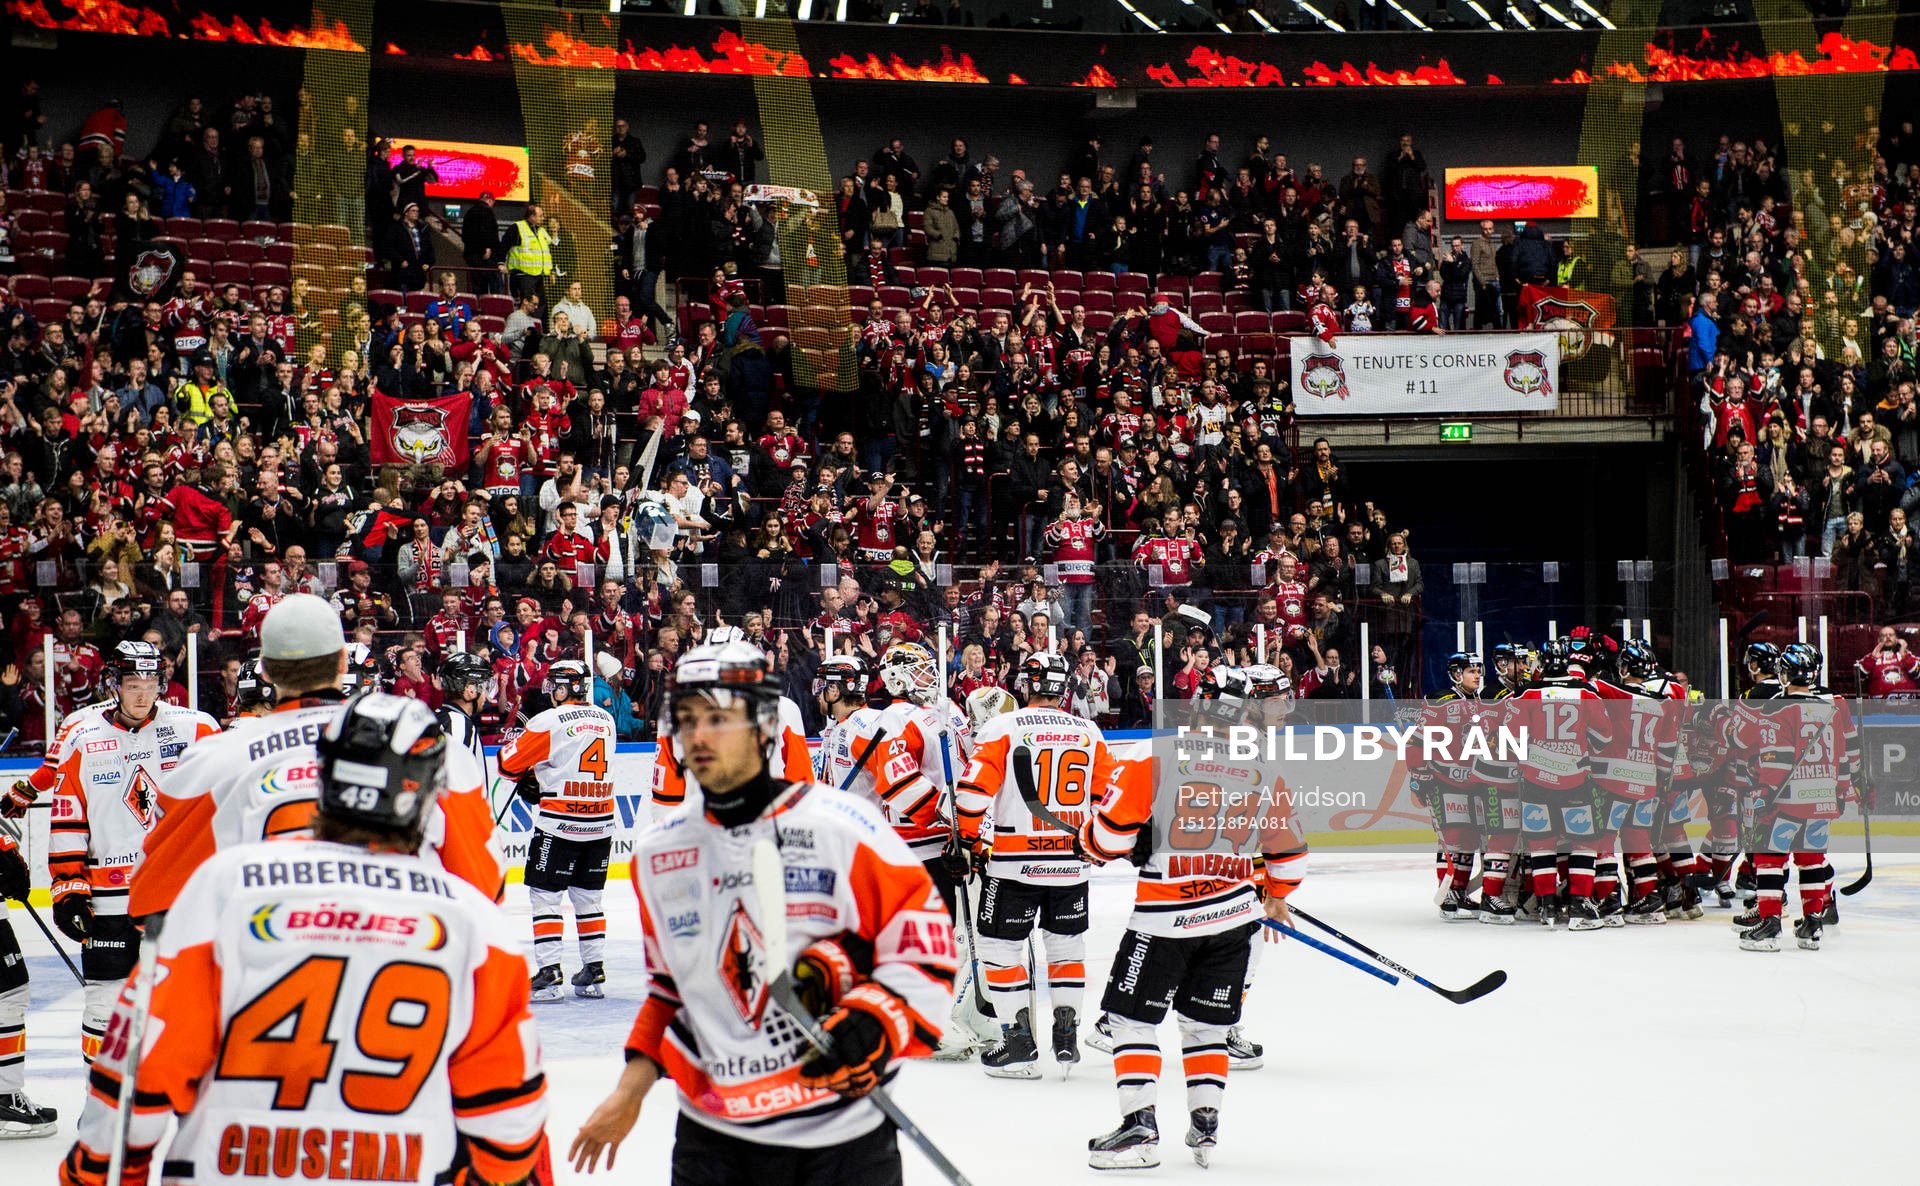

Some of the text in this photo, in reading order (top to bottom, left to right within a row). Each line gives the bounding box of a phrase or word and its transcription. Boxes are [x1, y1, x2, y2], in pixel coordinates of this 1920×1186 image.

[1432, 353, 1497, 368] CORNER
[1406, 380, 1438, 395] #11
[1049, 682, 1061, 692] 16
[1542, 703, 1579, 740] 12
[86, 741, 117, 753] SAVE
[157, 731, 176, 739] KRONA
[1035, 731, 1081, 743] BÖRJES
[1760, 728, 1777, 745] 39
[1800, 723, 1835, 763] 39
[578, 737, 608, 781] 4
[1193, 760, 1250, 779] BÖRJES
[1883, 743, 1907, 773] P
[92, 771, 121, 782] BAGA
[1034, 748, 1090, 806] 16
[339, 787, 379, 811] 49
[1487, 786, 1500, 828] akea
[535, 837, 554, 873] Sweden
[652, 848, 698, 873] SAVE
[718, 870, 753, 894] jala
[980, 877, 1001, 924] Sweden
[286, 902, 421, 936] BÖRJES
[668, 910, 700, 930] BAGA
[1118, 941, 1149, 995] Sweden
[1376, 953, 1418, 981] NEXUS
[214, 953, 453, 1116] 49
[217, 1122, 424, 1183] CRUSEMAN
